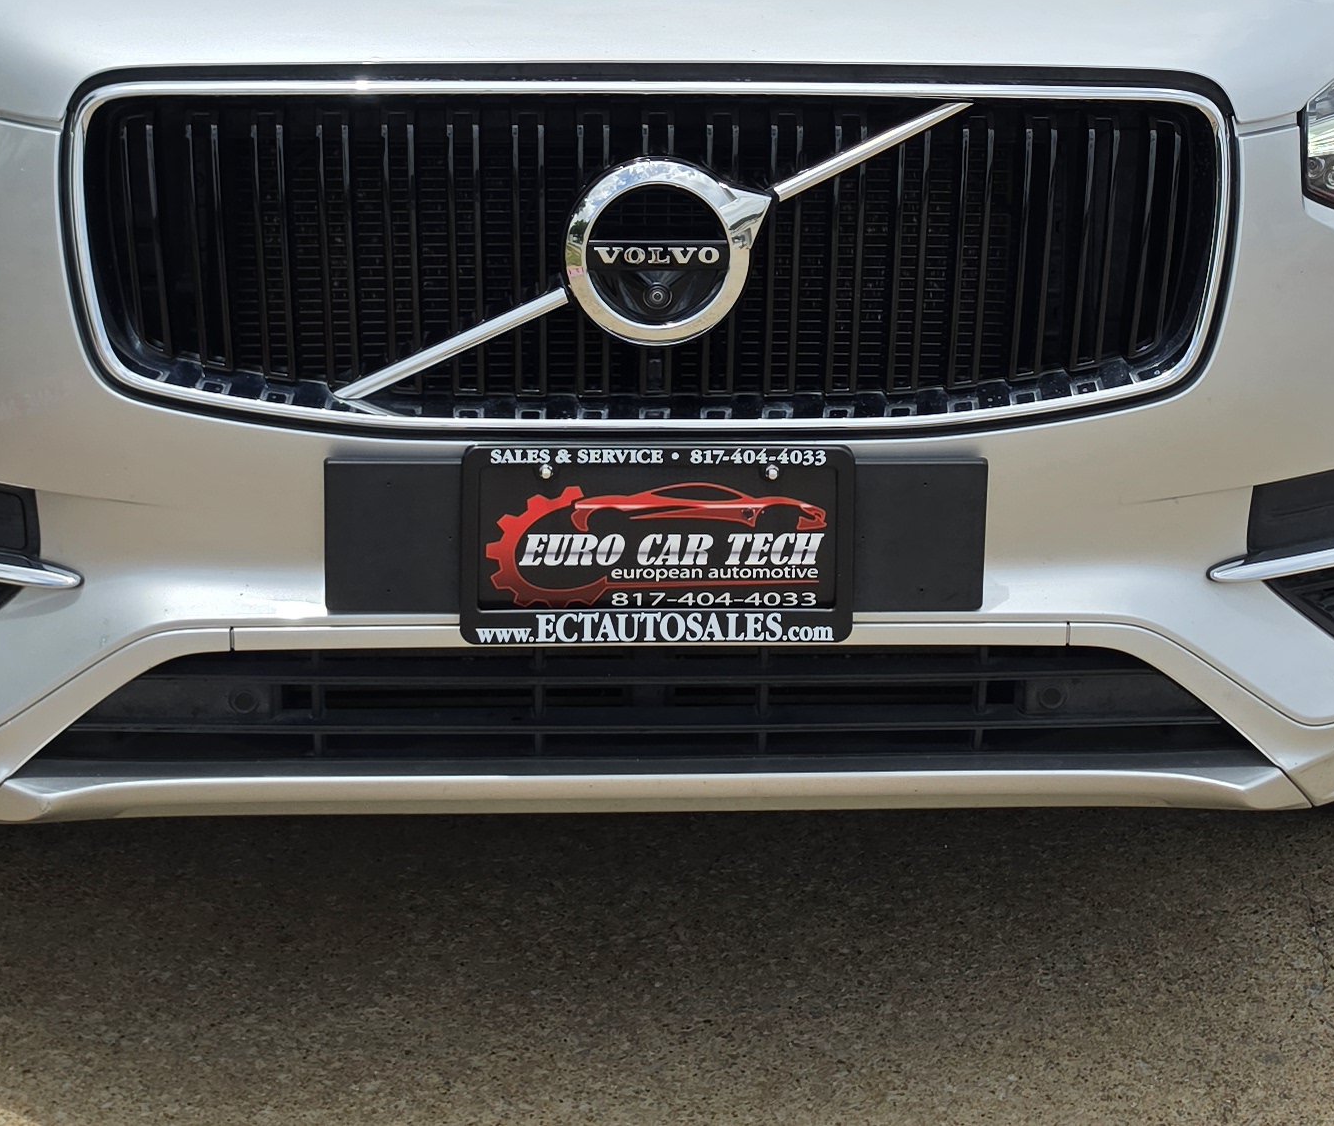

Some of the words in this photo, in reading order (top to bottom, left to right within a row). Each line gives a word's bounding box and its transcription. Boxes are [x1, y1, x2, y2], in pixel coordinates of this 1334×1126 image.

[593, 246, 720, 264] VOLVO
[490, 448, 551, 464] SALES
[555, 449, 572, 464] &
[577, 448, 664, 464] SERVICE
[689, 448, 827, 466] 817-404-4033
[519, 533, 626, 566] EURO
[637, 533, 714, 566] CAR
[725, 533, 827, 566] TECH
[611, 566, 703, 582] european
[707, 565, 819, 579] automotive
[611, 592, 817, 607] 817-404-4033
[476, 613, 834, 643] www.ECTAUTOSALES.com
